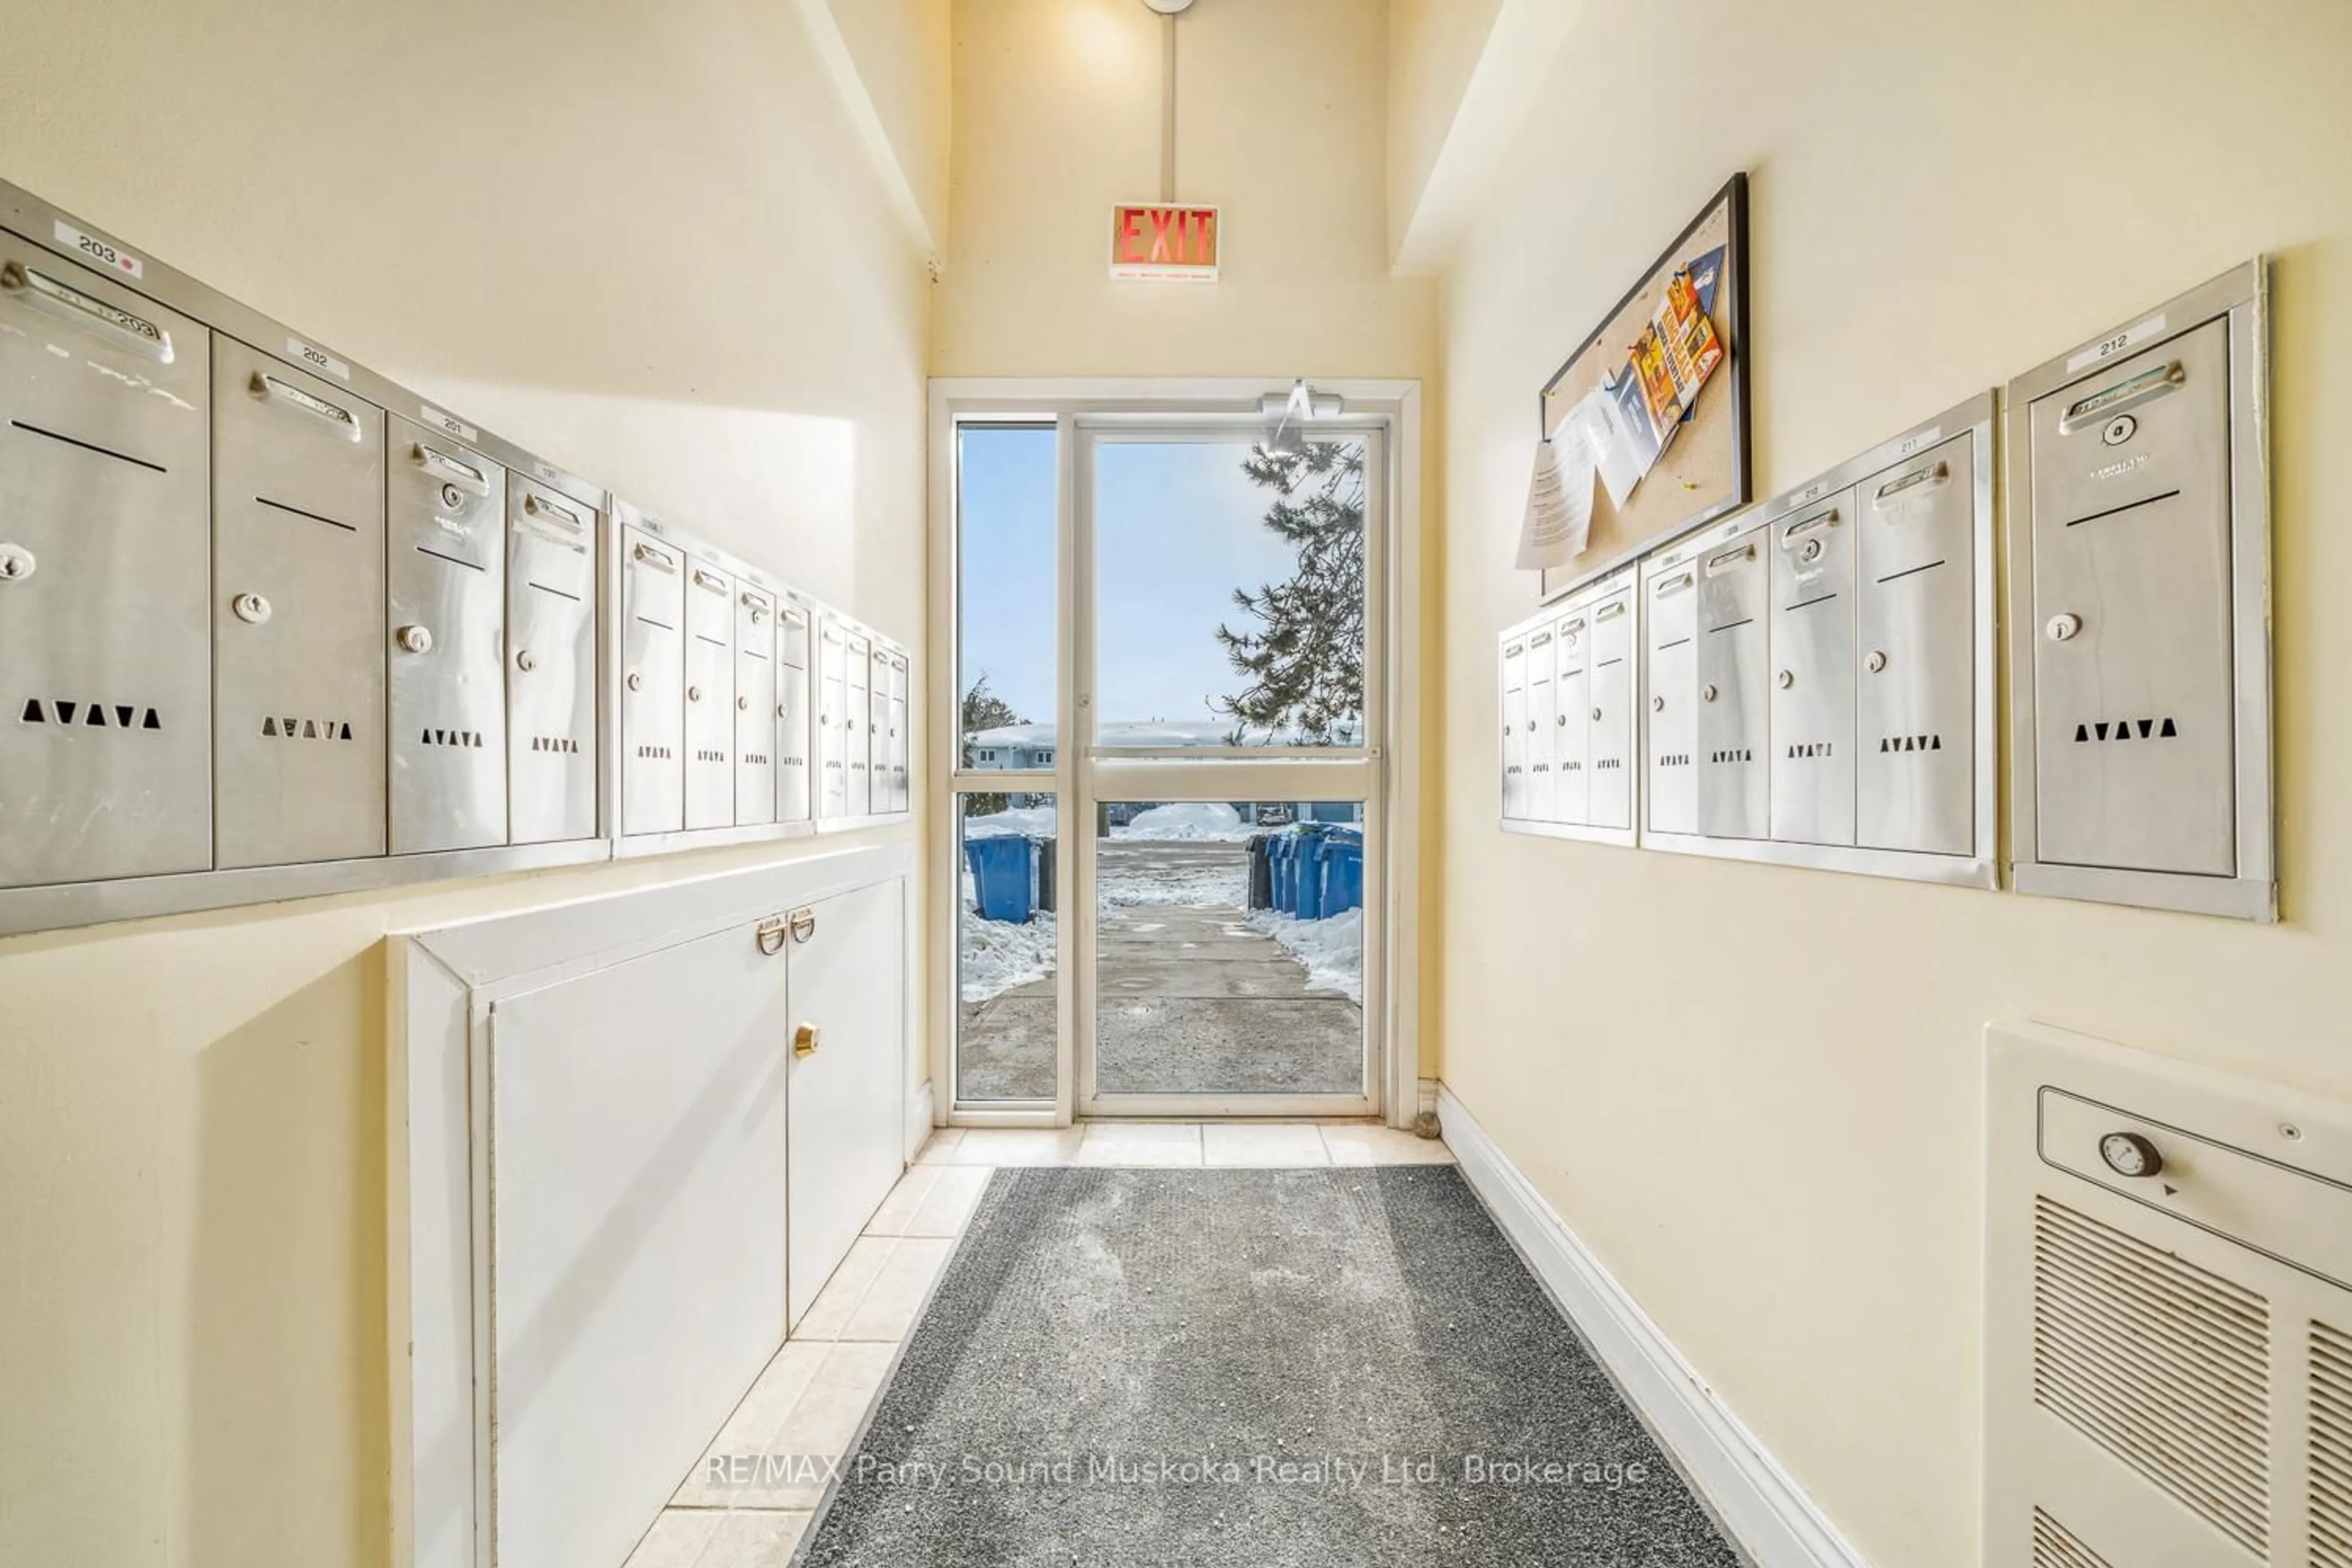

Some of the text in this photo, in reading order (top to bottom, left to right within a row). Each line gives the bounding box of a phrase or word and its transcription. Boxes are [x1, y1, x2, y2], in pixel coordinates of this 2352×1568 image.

[1123, 209, 1213, 263] EXIT
[79, 235, 116, 263] 203
[118, 313, 154, 336] 203
[2100, 334, 2127, 356] 212
[303, 347, 328, 368] 202
[444, 418, 461, 433] 201
